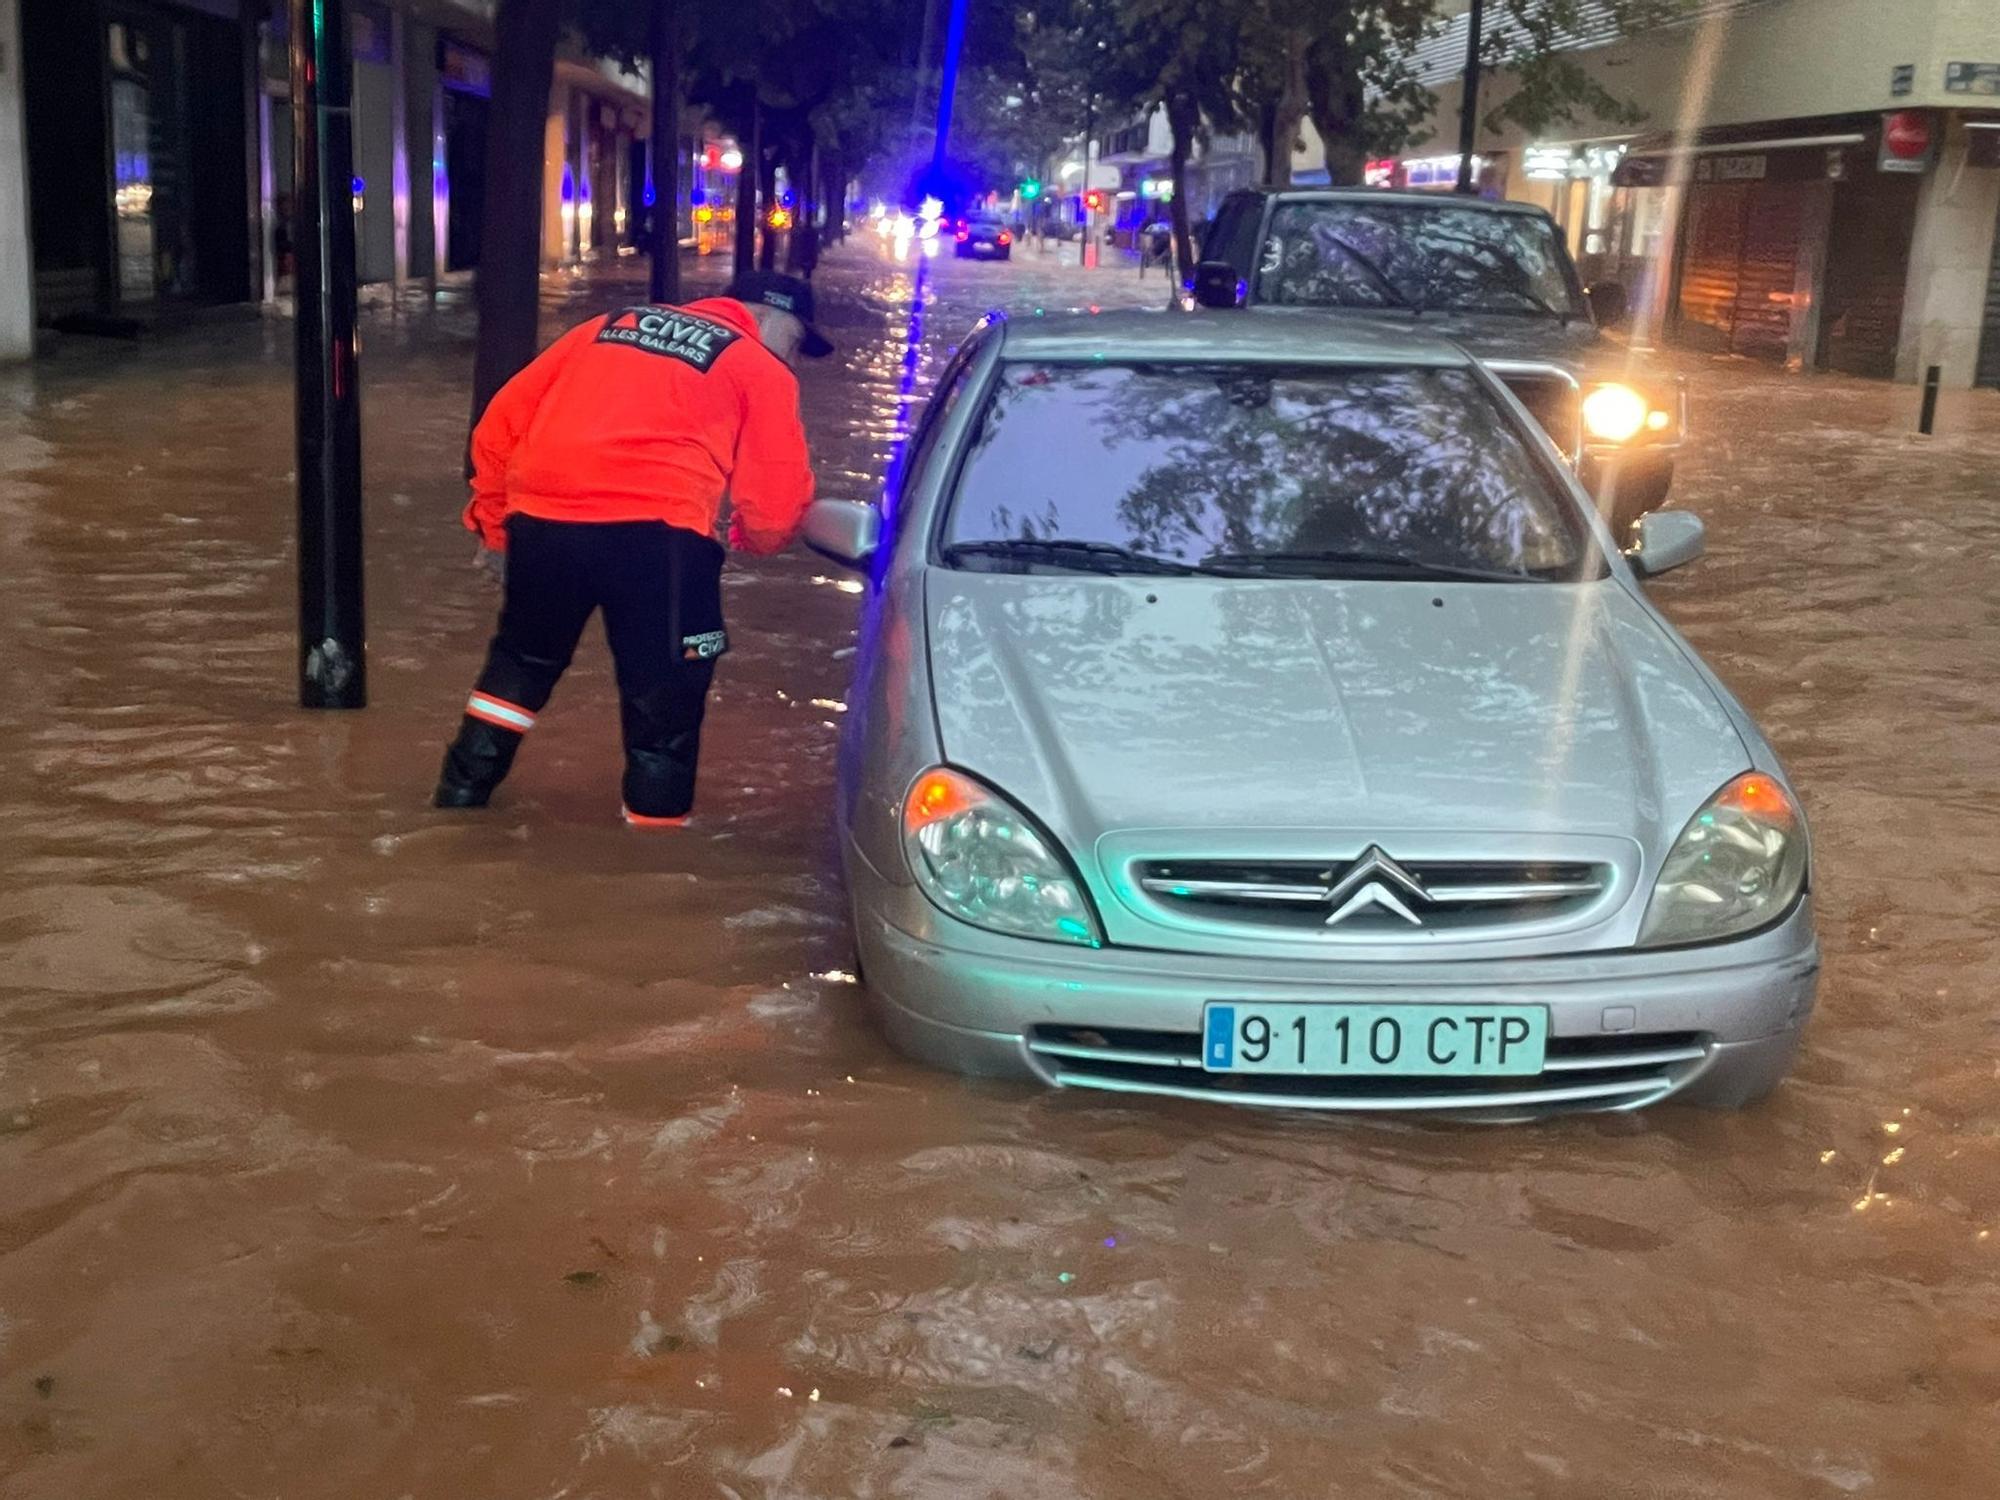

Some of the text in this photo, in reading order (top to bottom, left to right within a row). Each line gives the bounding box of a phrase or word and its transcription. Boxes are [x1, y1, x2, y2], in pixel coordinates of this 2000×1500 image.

[600, 328, 706, 363] ILLES BALEARS
[639, 315, 712, 351] CIVIL
[1240, 1015, 1530, 1065] 9110 CTP
